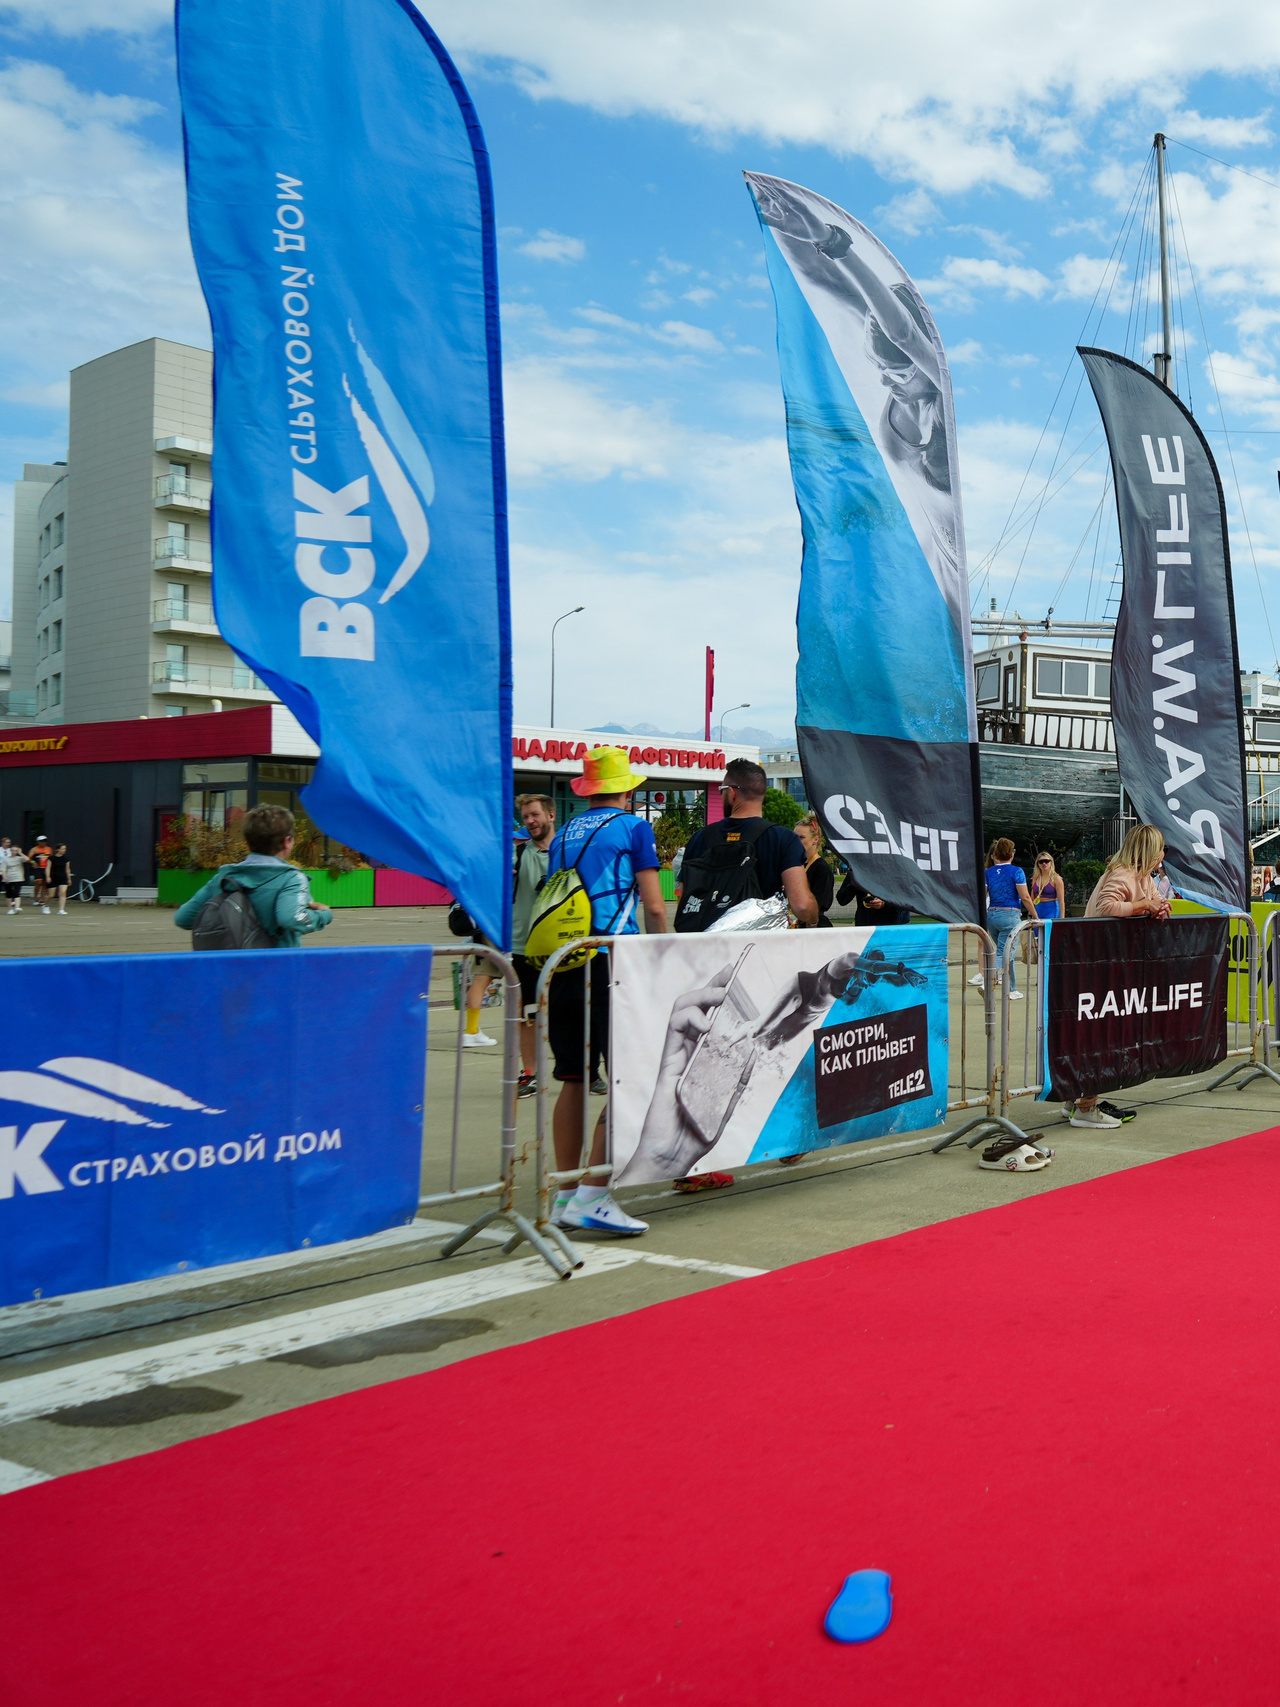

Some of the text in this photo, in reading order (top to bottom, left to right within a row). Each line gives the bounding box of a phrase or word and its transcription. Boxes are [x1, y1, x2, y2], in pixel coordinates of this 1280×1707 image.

[570, 812, 617, 825] OSATOM
[820, 1022, 888, 1054] СМОТРИ,
[820, 1036, 916, 1076] КАК ПЛЫВЕТ
[888, 1068, 926, 1100] TELE2
[68, 1132, 266, 1187] СТРАХОВОЙ
[274, 1127, 342, 1163] ДОМ
